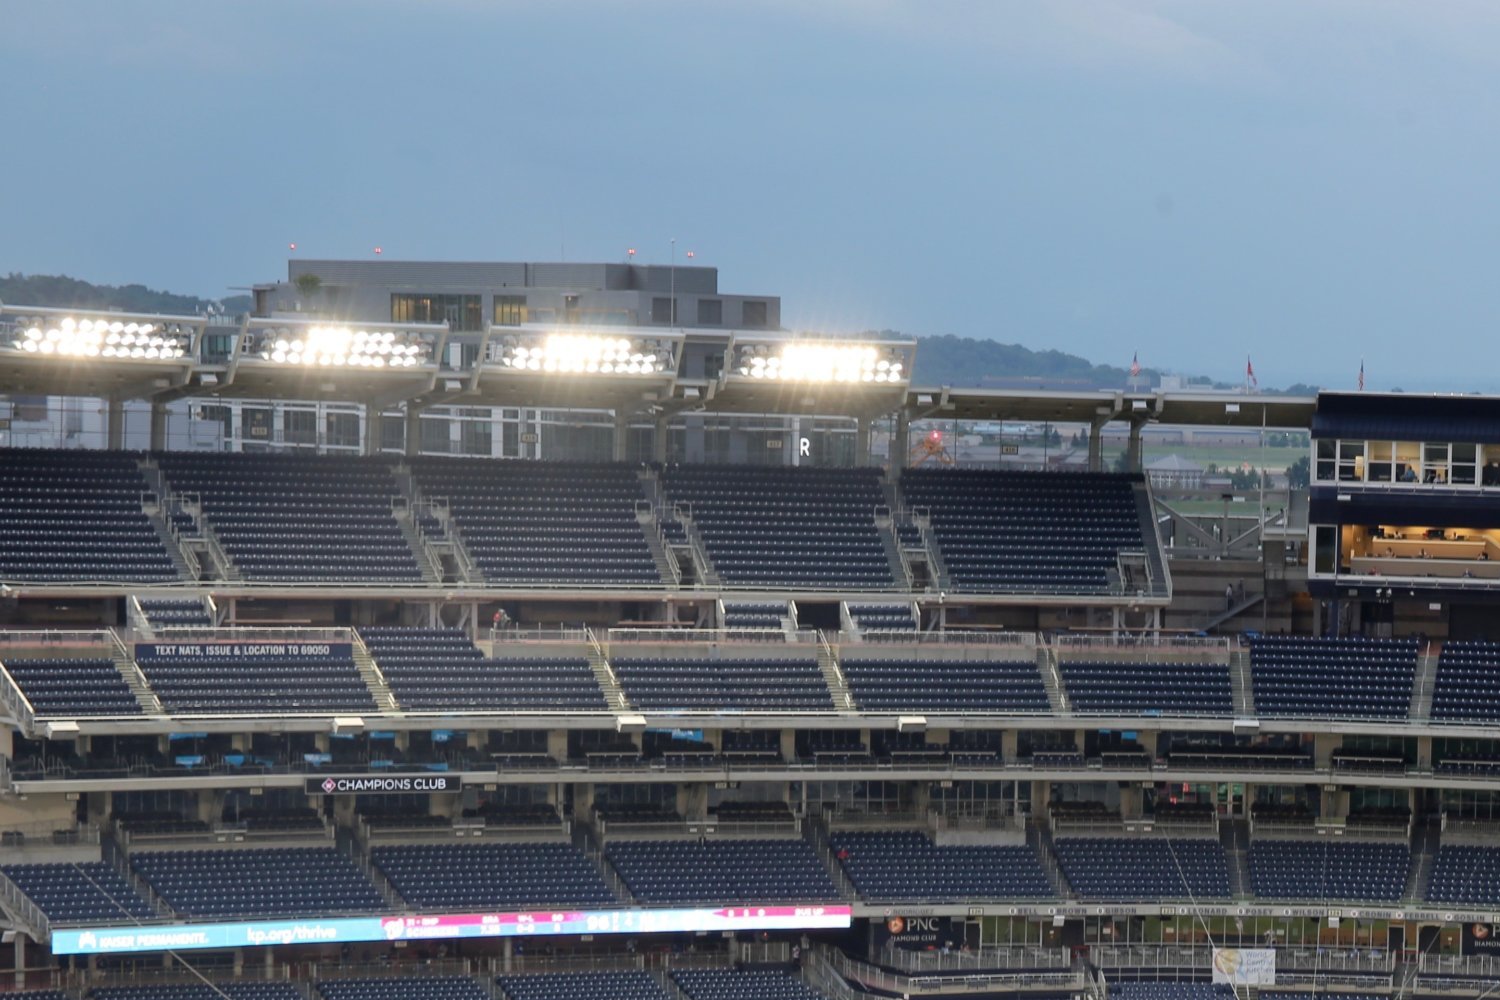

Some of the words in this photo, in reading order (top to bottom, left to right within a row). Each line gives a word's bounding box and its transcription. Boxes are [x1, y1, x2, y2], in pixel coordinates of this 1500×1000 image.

[800, 437, 810, 456] R
[155, 645, 176, 656] TEXT
[179, 645, 204, 657] NATS,
[206, 645, 232, 656] ISSUE
[233, 645, 241, 656] &
[243, 645, 285, 655] LOCATION
[287, 645, 299, 655] TO
[301, 644, 330, 655] 69050
[337, 779, 411, 791] CHAMPIONS
[413, 778, 447, 790] CLUB
[1292, 908, 1325, 916] WILSON
[1359, 911, 1391, 919] CRONIN
[1454, 914, 1485, 922] GOSLIN
[907, 918, 939, 931] PNC
[247, 926, 336, 945] kp.org/thrive
